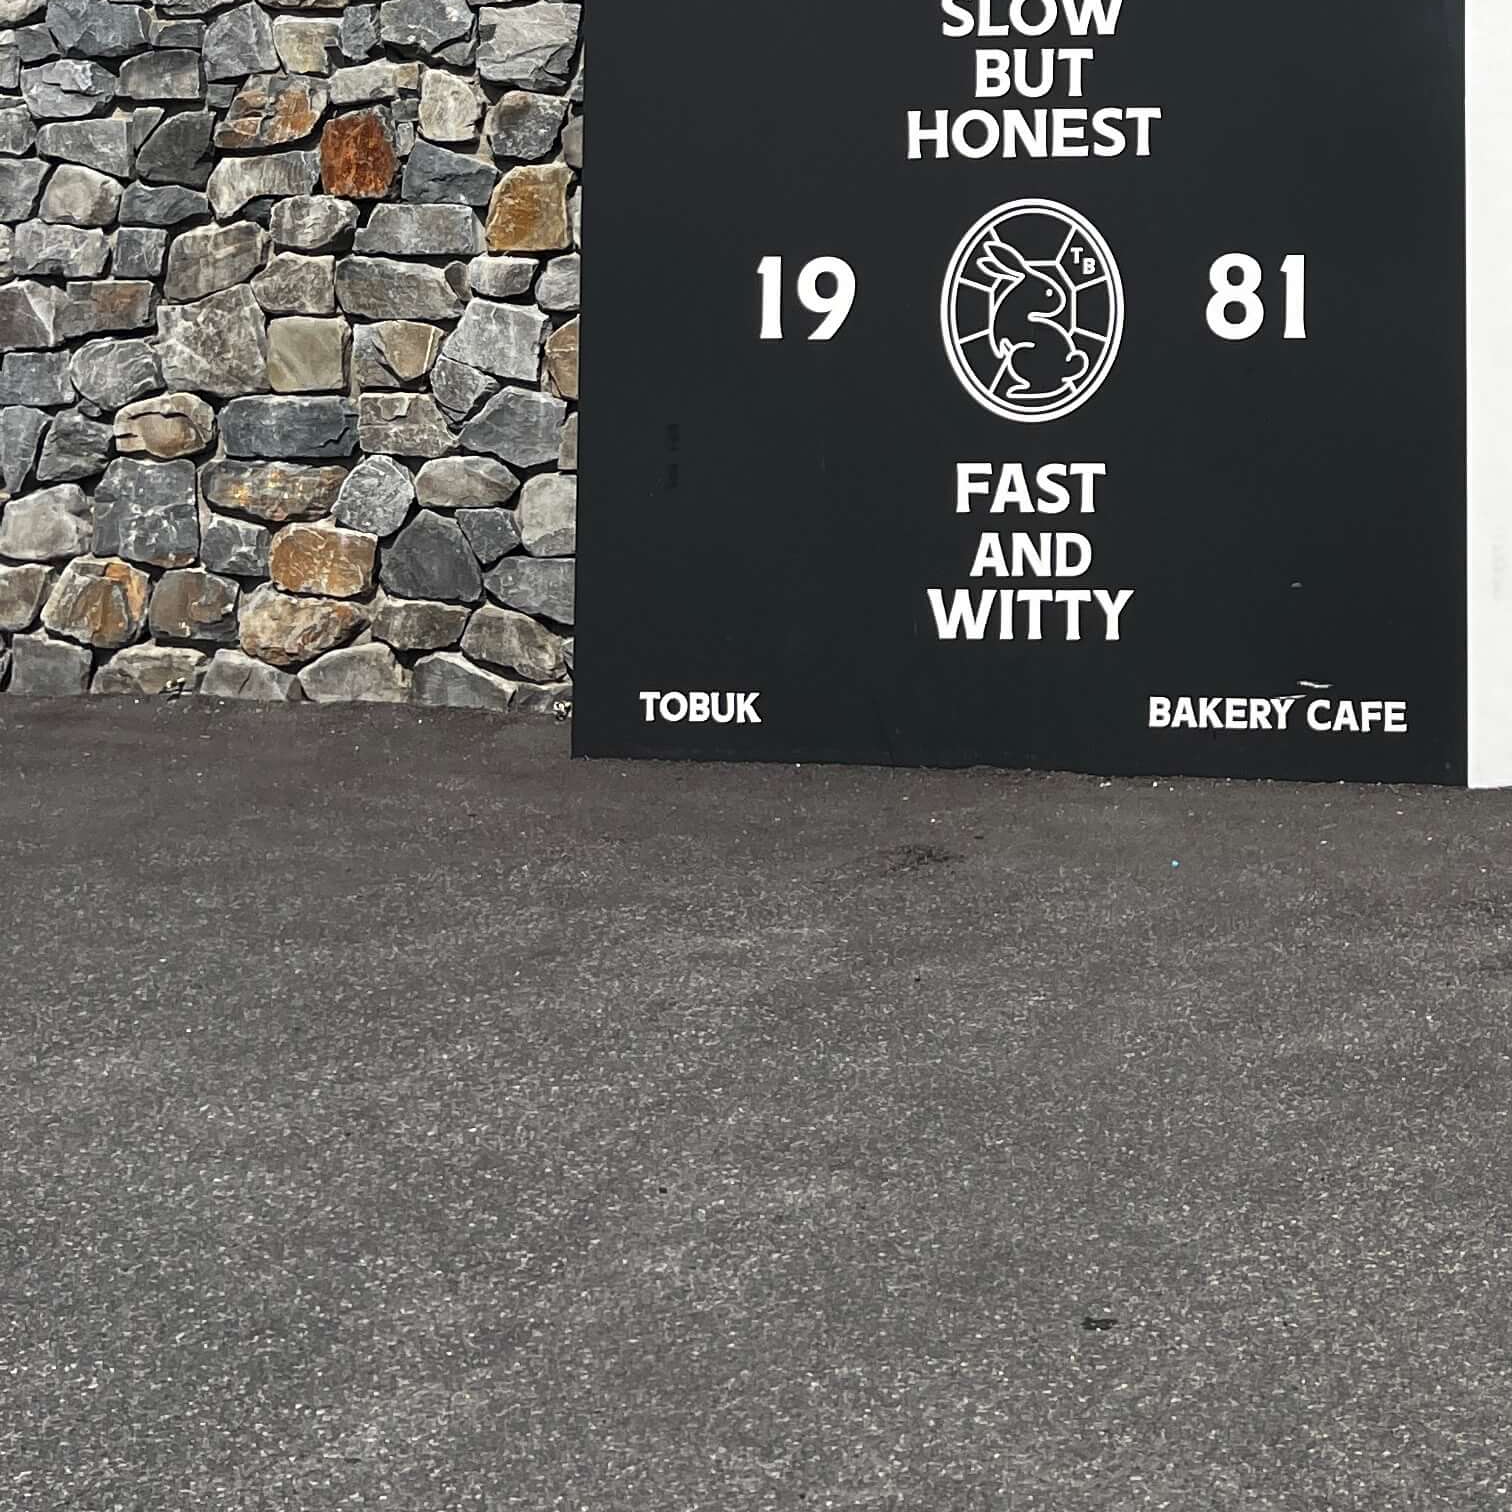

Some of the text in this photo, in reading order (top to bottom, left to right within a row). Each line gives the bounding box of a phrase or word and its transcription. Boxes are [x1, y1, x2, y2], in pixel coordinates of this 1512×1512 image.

[974, 48, 1094, 98] BUT
[907, 107, 1162, 160] HONEST
[756, 252, 1307, 341] 19 81
[955, 462, 1107, 514] FAST
[969, 532, 1092, 577] AND
[926, 588, 1135, 641] WITTY
[639, 691, 762, 724] TOBUK
[1148, 696, 1408, 733] BAKERY CAFE
